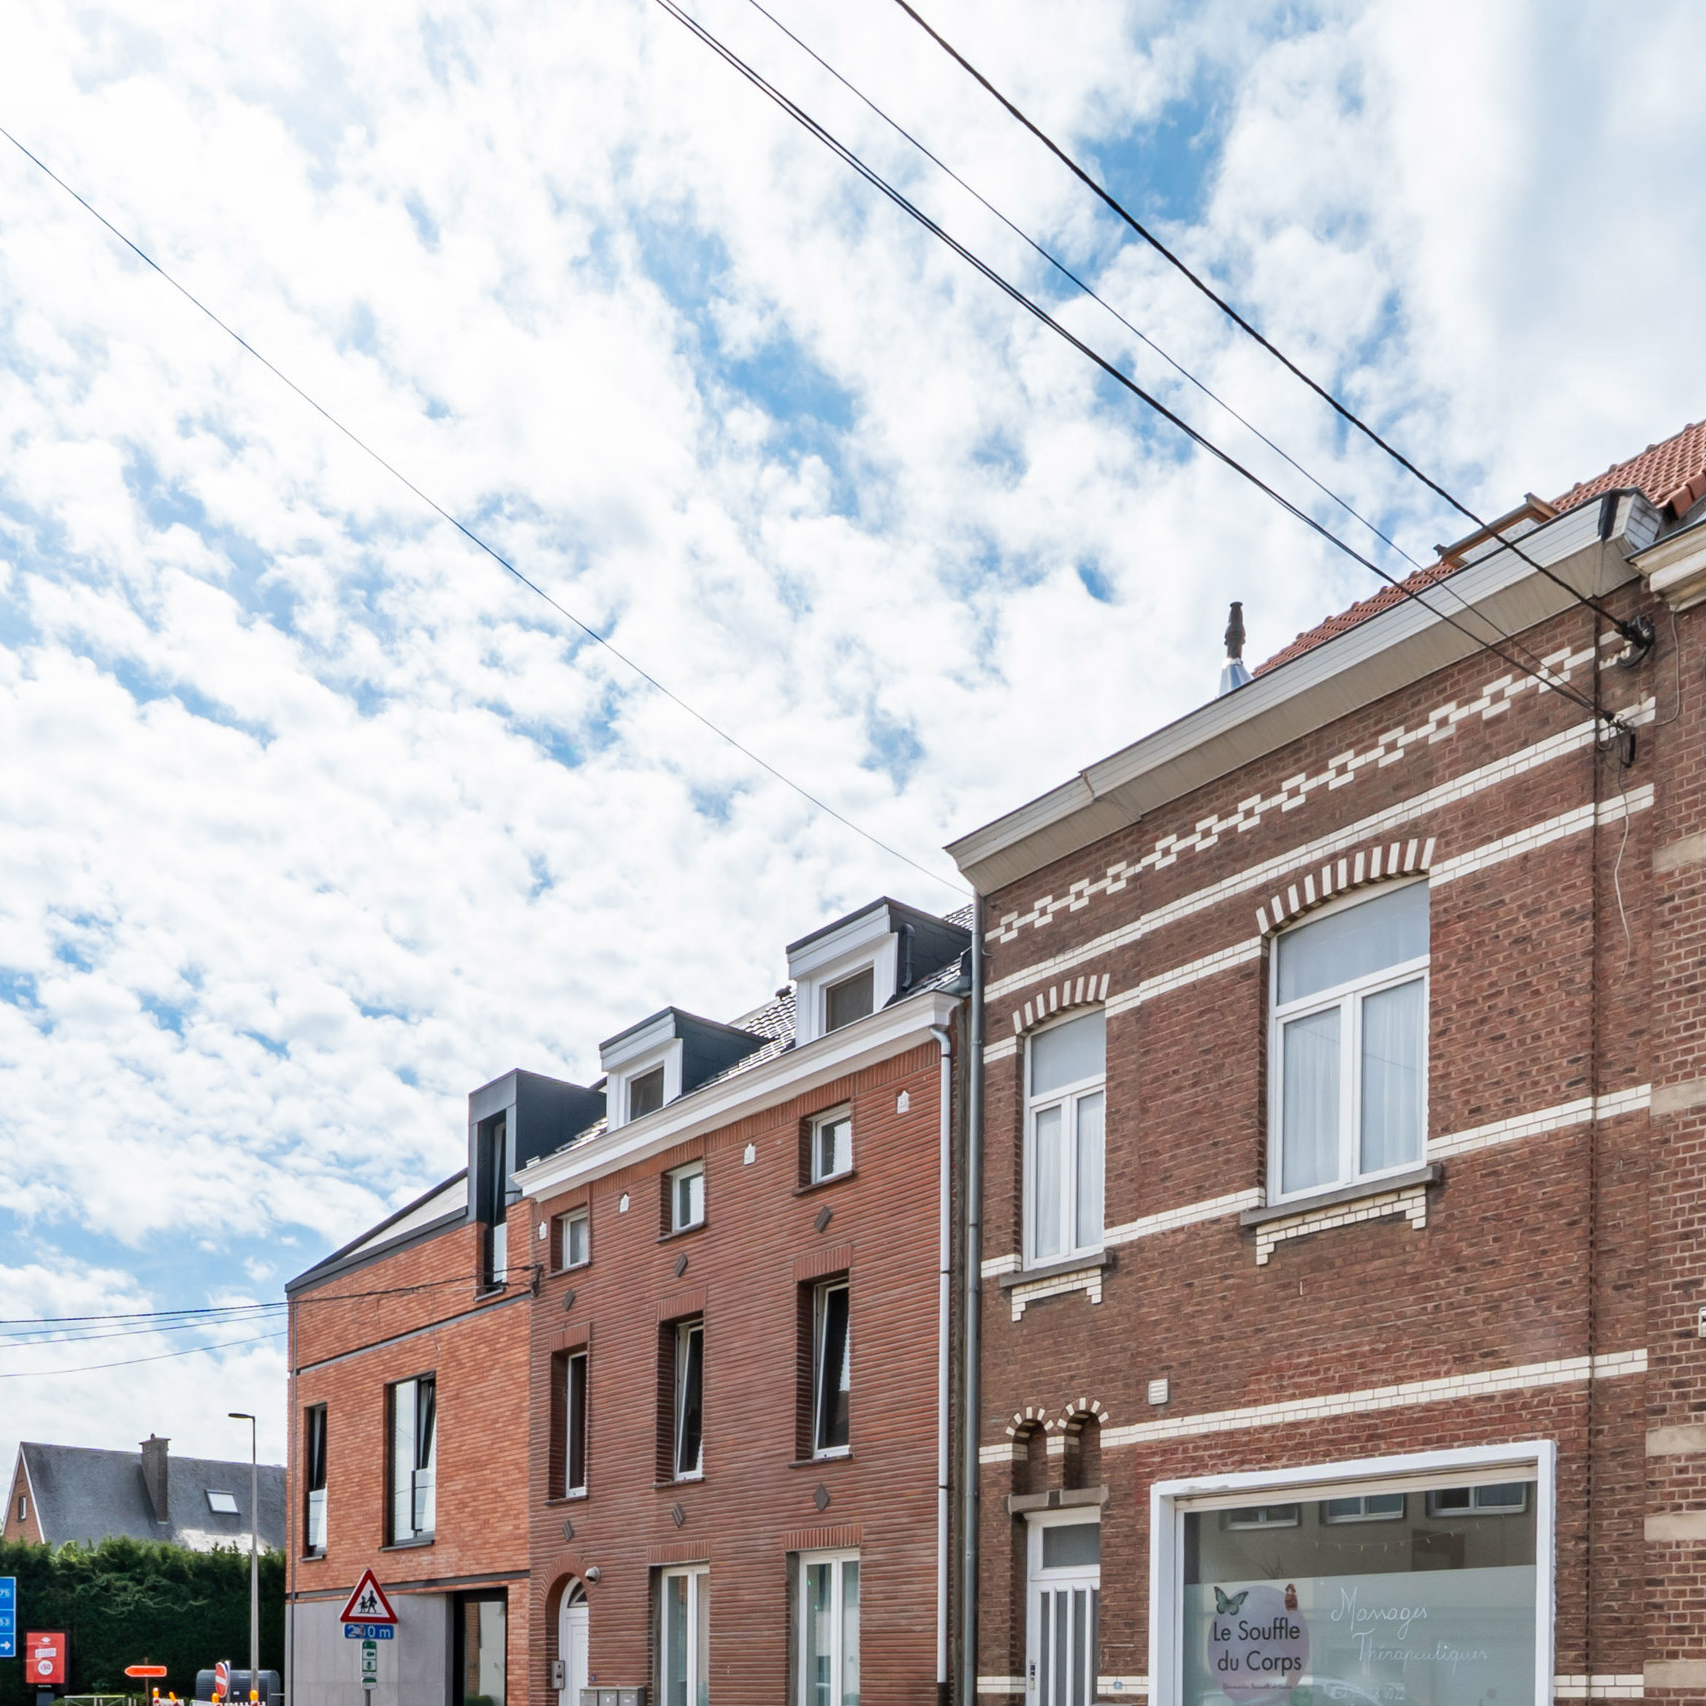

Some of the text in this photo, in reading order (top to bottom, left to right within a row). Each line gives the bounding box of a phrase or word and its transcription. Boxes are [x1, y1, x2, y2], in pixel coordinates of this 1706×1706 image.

[1331, 1586, 1428, 1640] Massages
[379, 1628, 391, 1638] m
[1213, 1617, 1300, 1641] Le Souffle
[1217, 1649, 1302, 1677] du Corps
